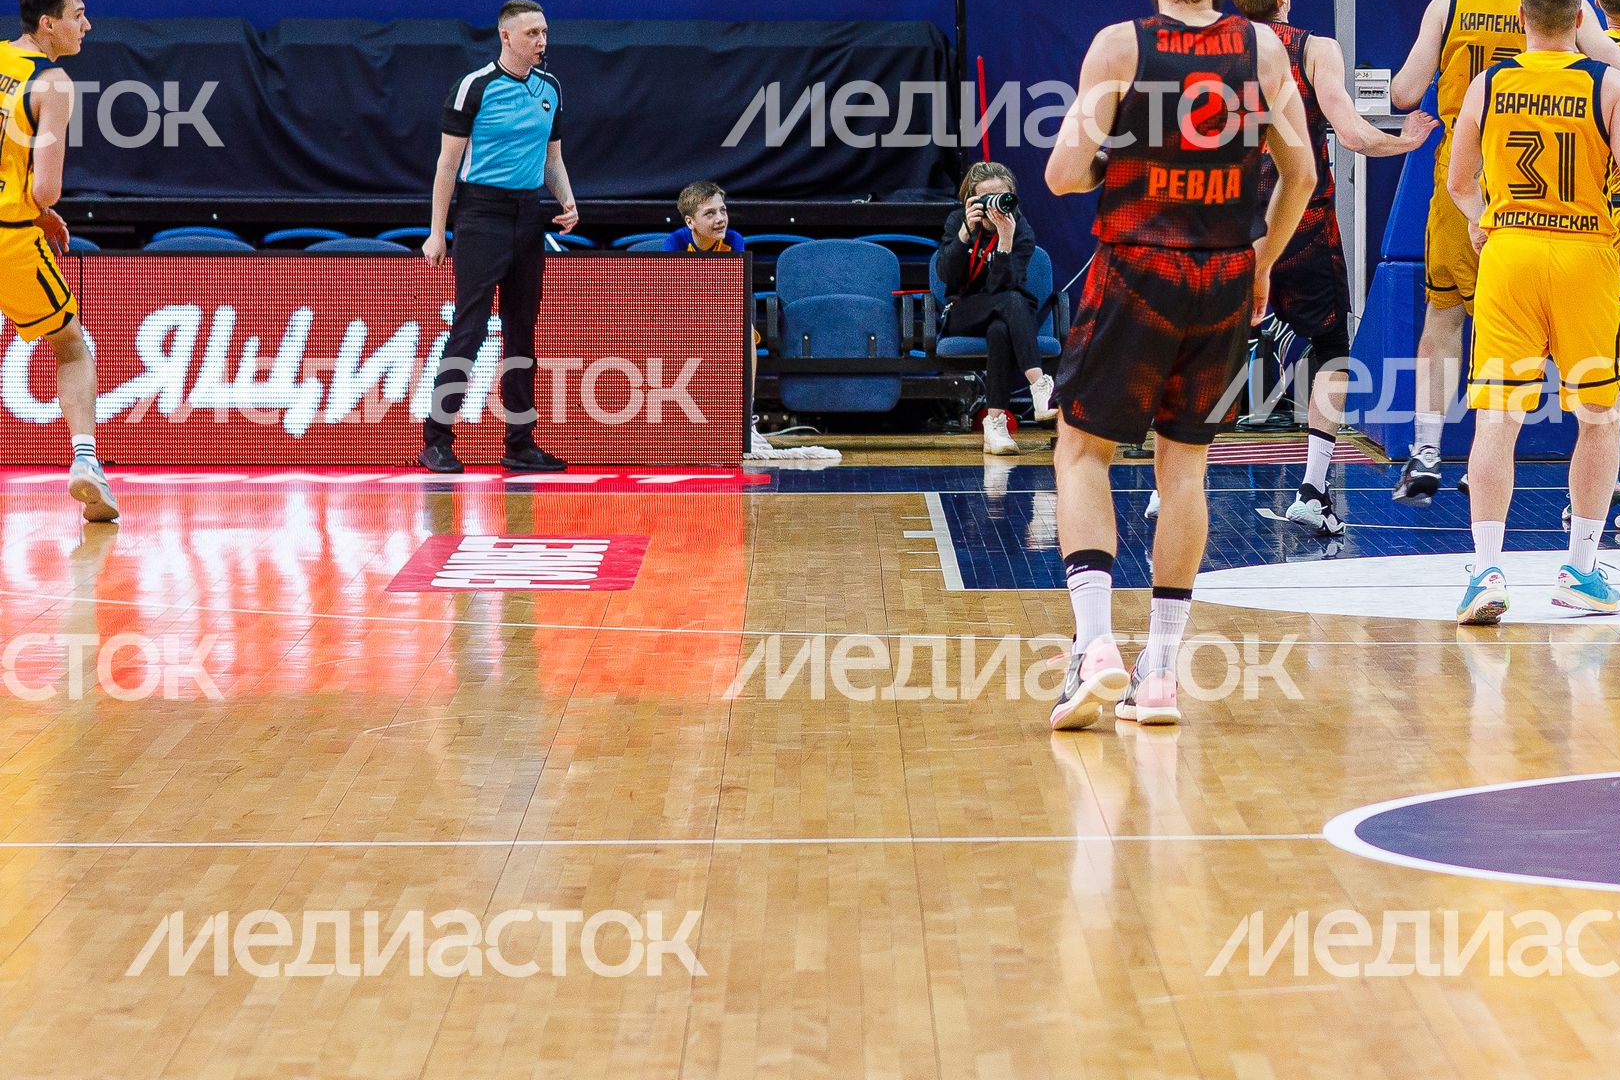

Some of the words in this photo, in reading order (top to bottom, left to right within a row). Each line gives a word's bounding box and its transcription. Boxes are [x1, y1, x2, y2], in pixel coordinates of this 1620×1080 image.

[1460, 12, 1526, 34] КАРПЕНК
[1180, 71, 1224, 151] 2
[1495, 92, 1588, 119] ВАРНАКОВ
[1148, 164, 1241, 205] РЕВДА
[1505, 131, 1576, 203] 31
[1493, 211, 1600, 231] МОСКОВСКАЯ
[430, 536, 611, 590] FONBET
